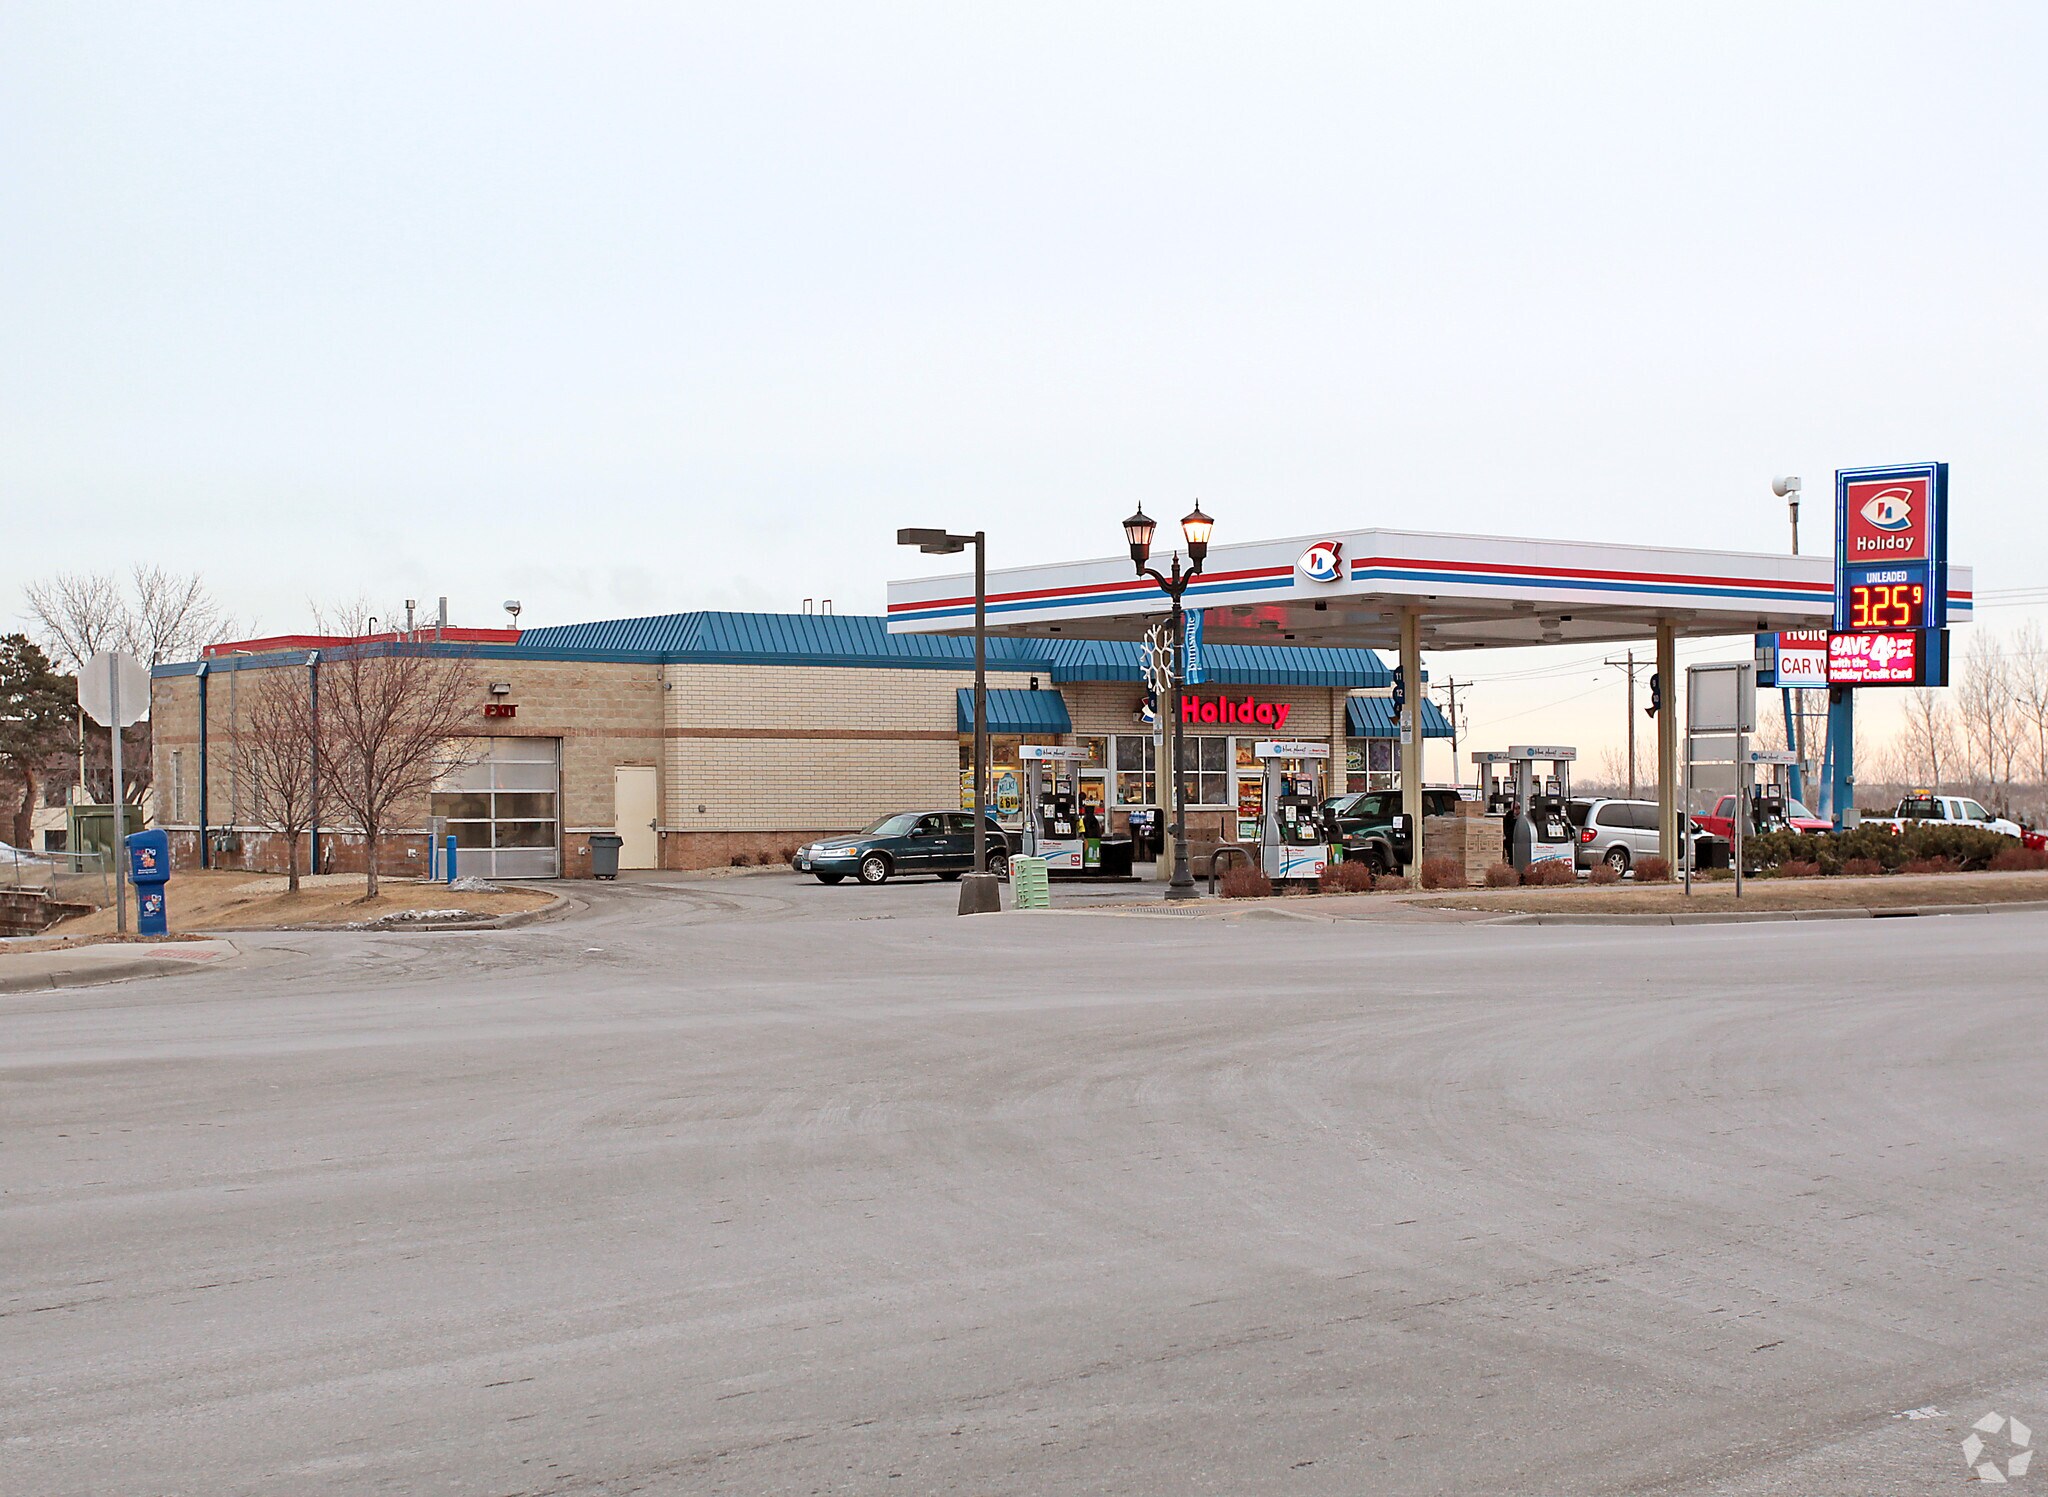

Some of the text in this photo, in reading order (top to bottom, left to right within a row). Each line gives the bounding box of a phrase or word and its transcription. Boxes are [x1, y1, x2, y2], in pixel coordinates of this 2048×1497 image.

[1857, 536, 1914, 551] Holiday
[1866, 571, 1907, 583] UNLEADED
[1830, 635, 1871, 656] SAVE
[1781, 657, 1811, 674] CAR
[1830, 657, 1868, 668] with the
[1830, 668, 1912, 682] Holiday Credit Card
[484, 705, 518, 717] EXIT
[1181, 696, 1291, 730] Holiday
